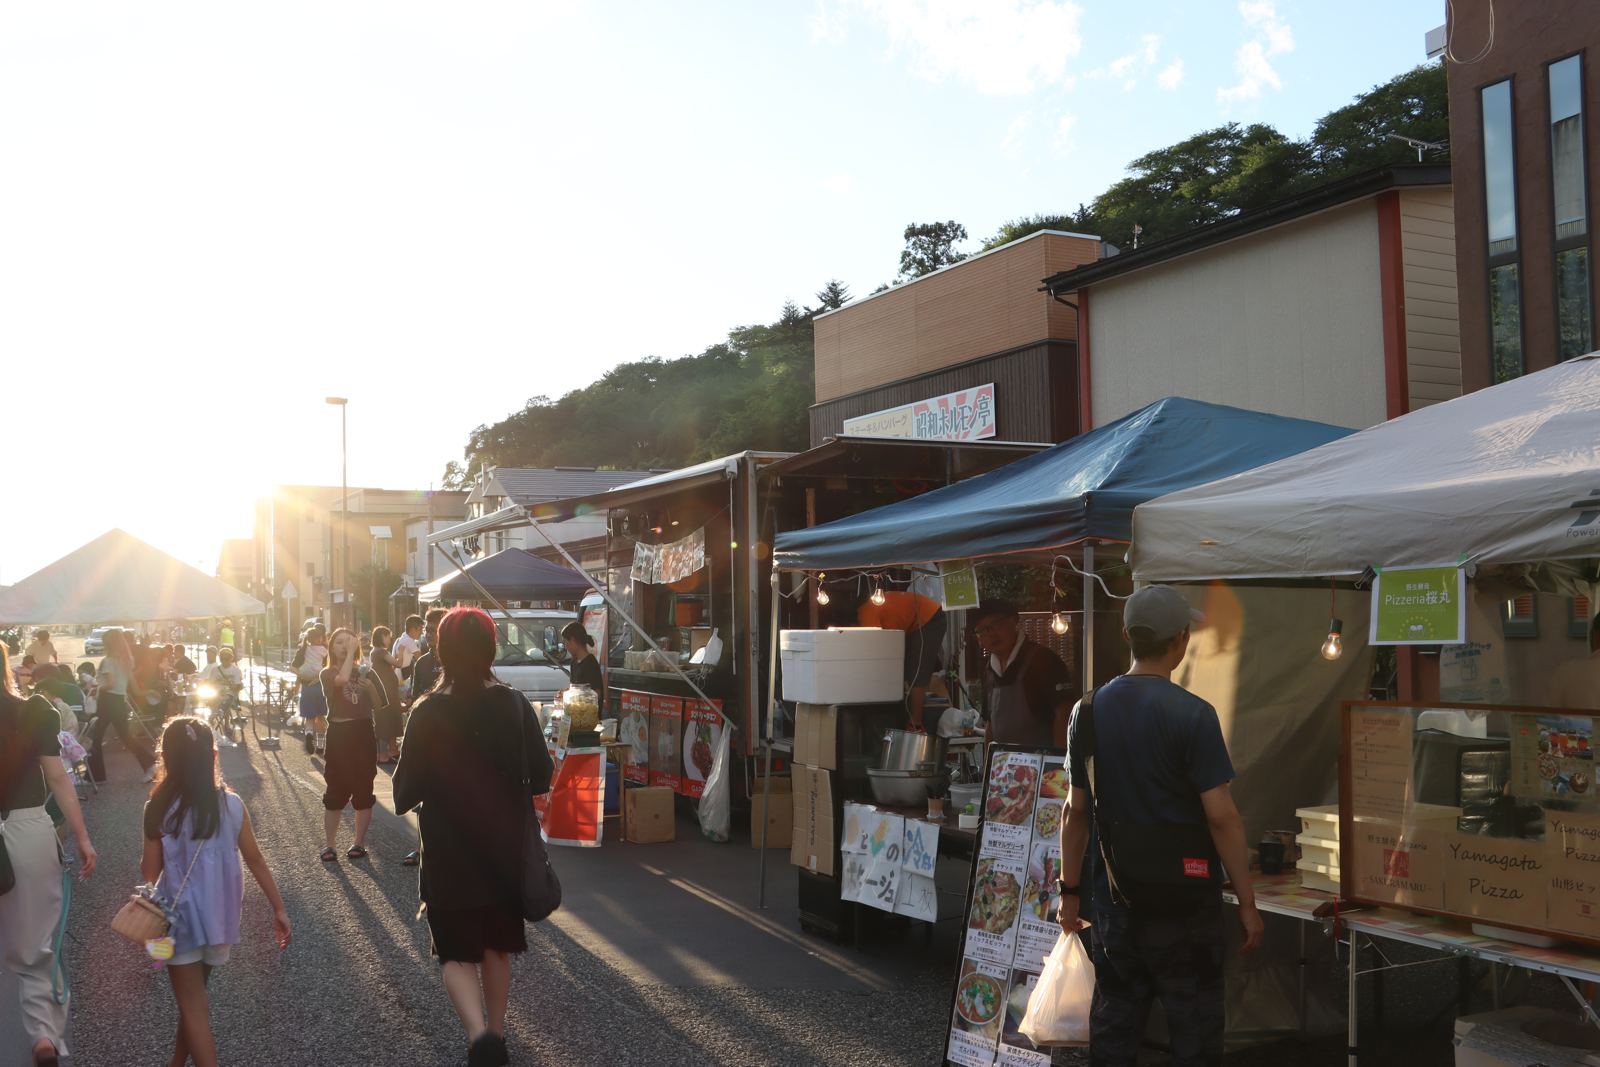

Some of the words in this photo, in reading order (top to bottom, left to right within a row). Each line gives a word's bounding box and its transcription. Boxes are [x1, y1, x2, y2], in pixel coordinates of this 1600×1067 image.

[915, 396, 990, 438] 昭和ホルモン亭
[1385, 591, 1450, 605] Pizzeria桜丸
[886, 843, 899, 862] の
[1449, 843, 1543, 871] Yamagata
[1468, 878, 1524, 900] Pizza
